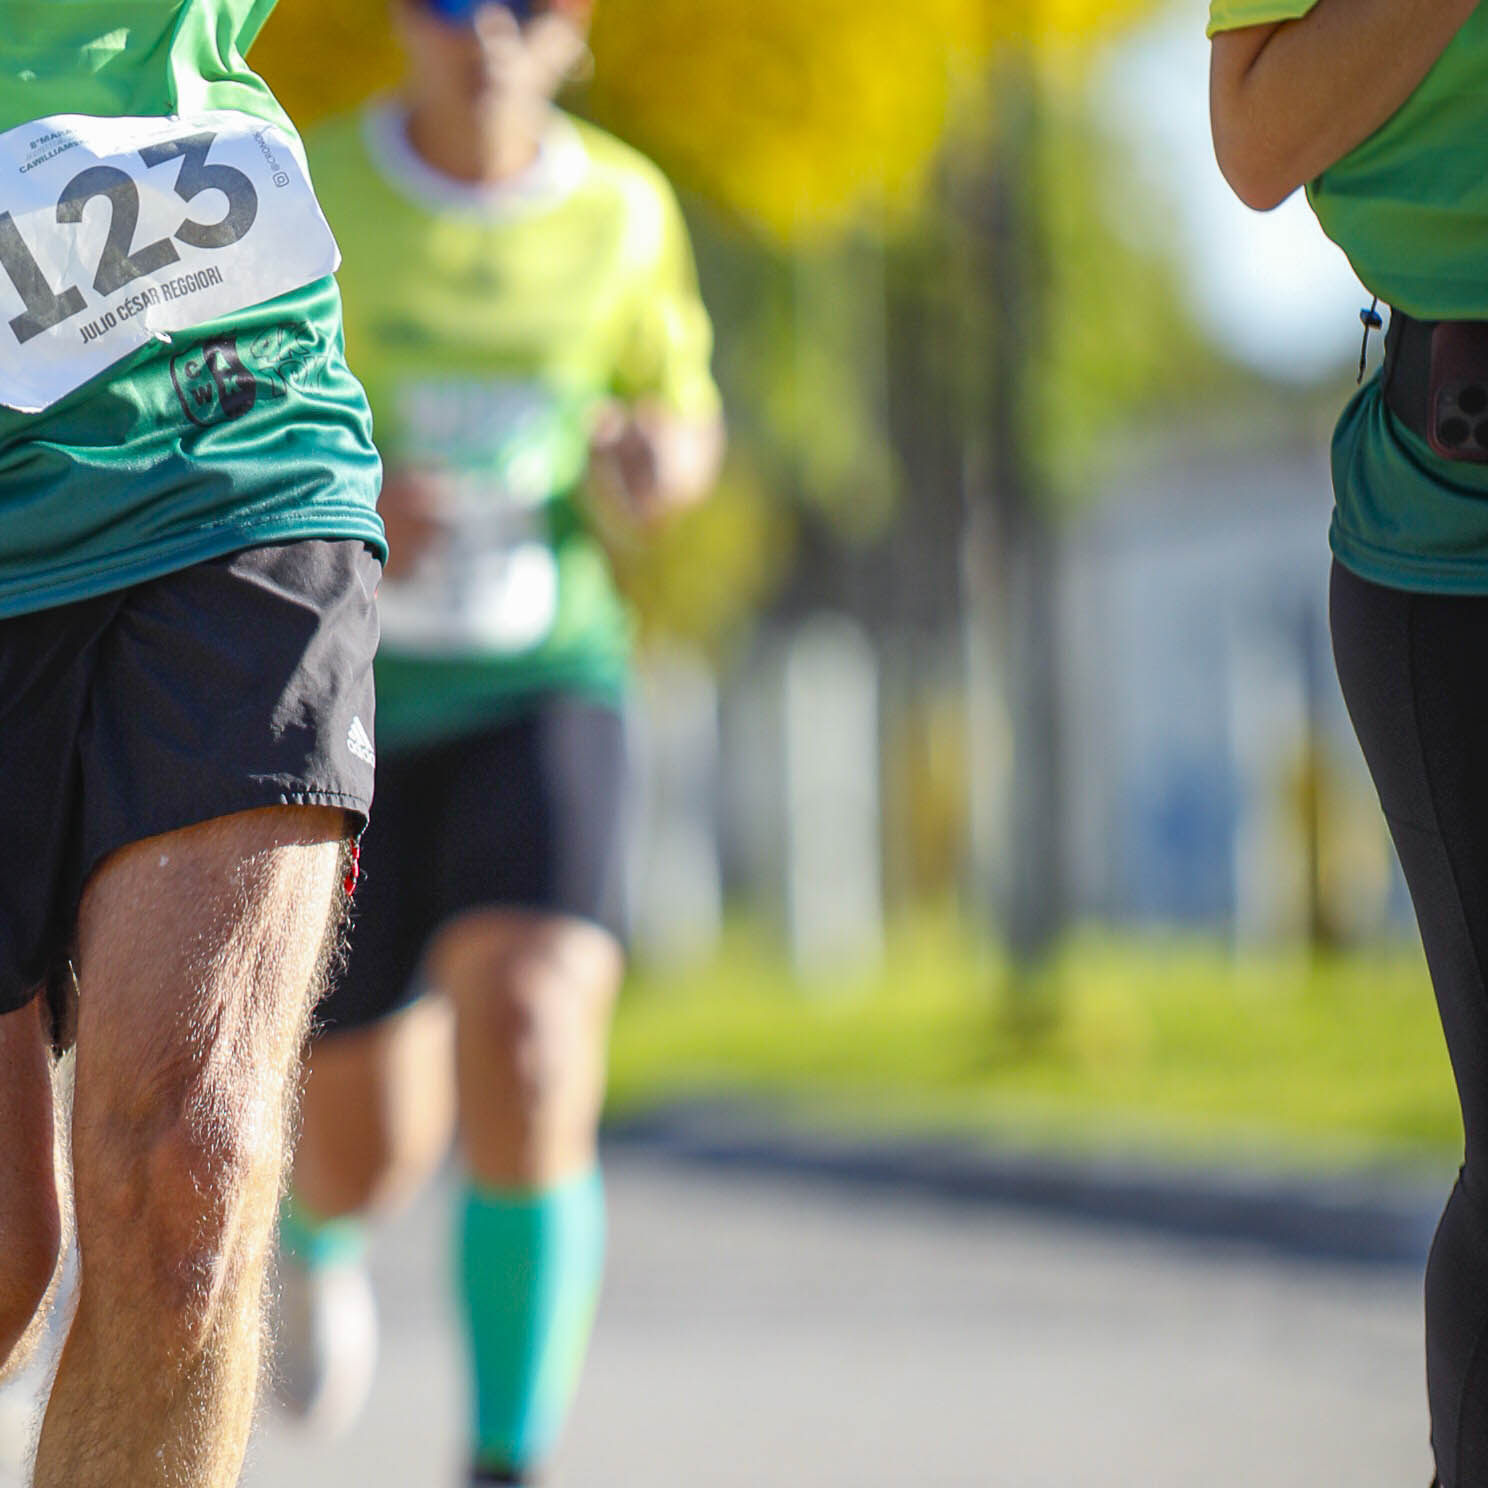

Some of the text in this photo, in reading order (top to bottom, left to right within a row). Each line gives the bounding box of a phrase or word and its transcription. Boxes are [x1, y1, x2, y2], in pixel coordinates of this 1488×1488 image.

[79, 265, 224, 344] JULIO CÉSAR REGGIORI
